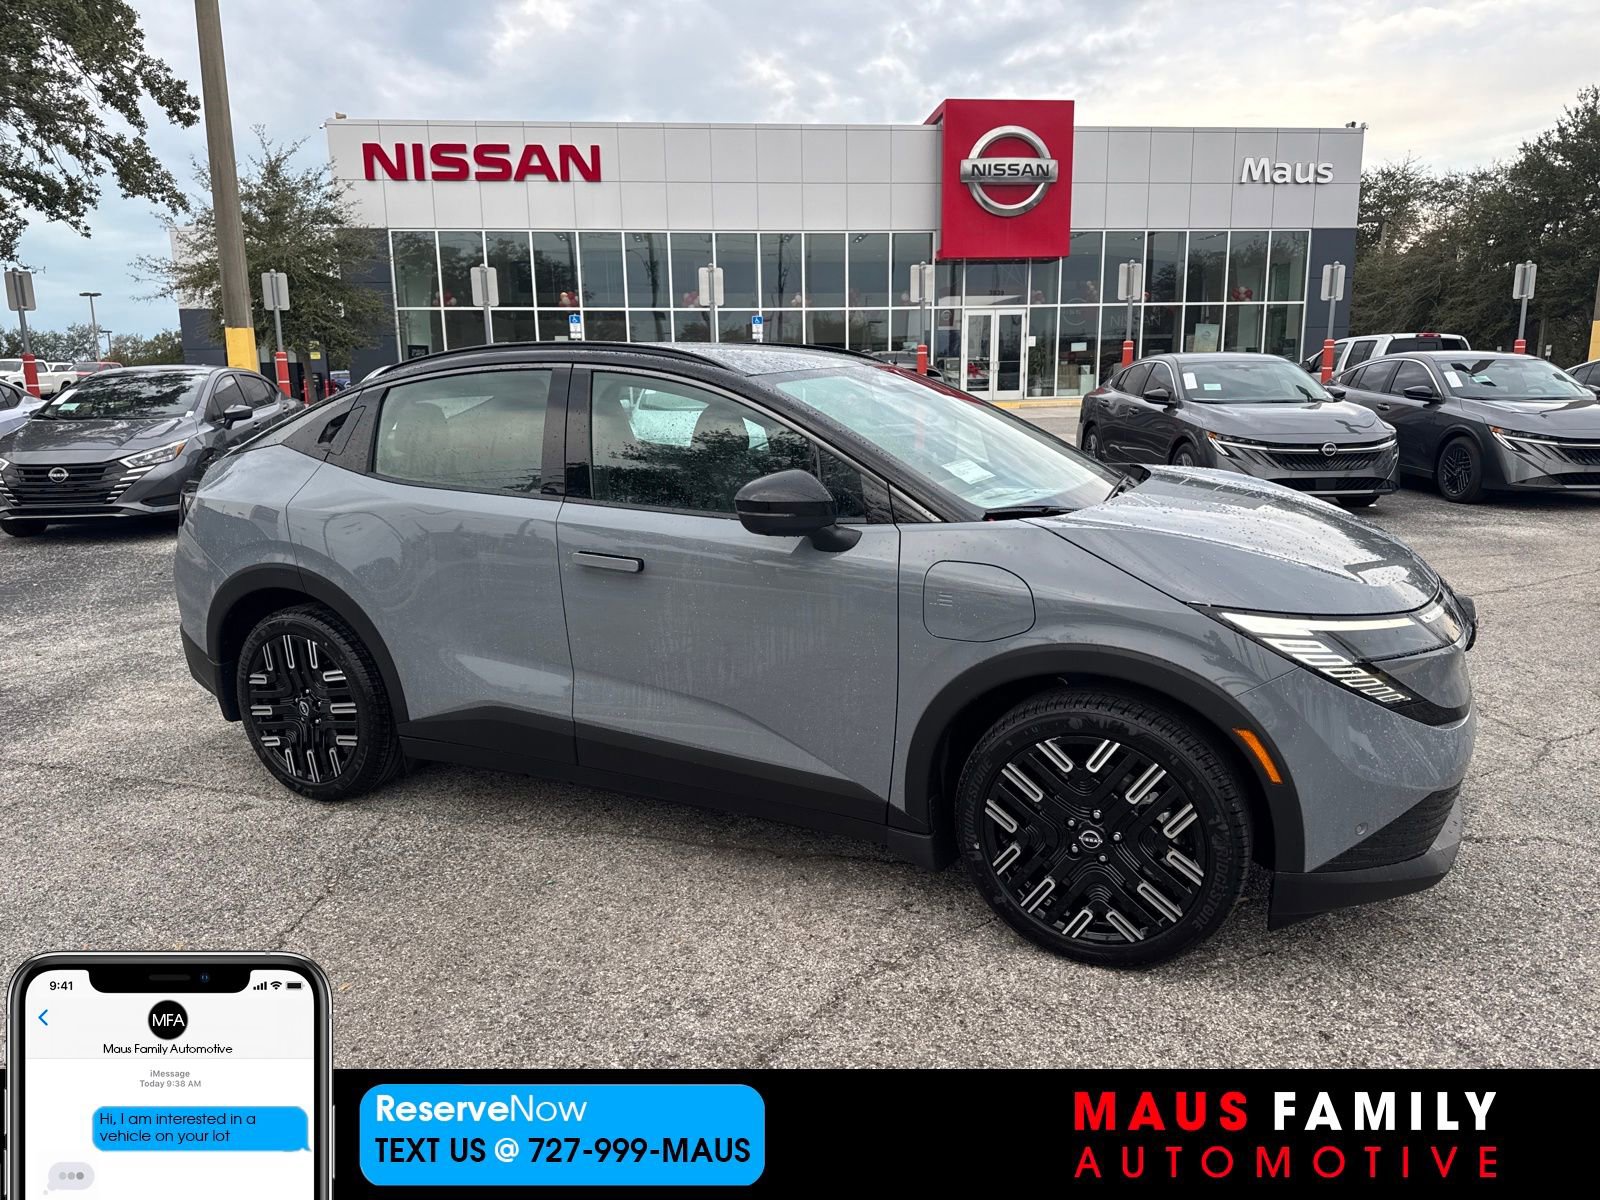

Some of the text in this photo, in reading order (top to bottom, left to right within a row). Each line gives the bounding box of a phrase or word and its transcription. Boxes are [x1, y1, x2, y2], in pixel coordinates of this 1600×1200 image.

[362, 142, 602, 182] NISSAN
[970, 162, 1051, 178] NISSAN
[1240, 157, 1334, 184] Maus
